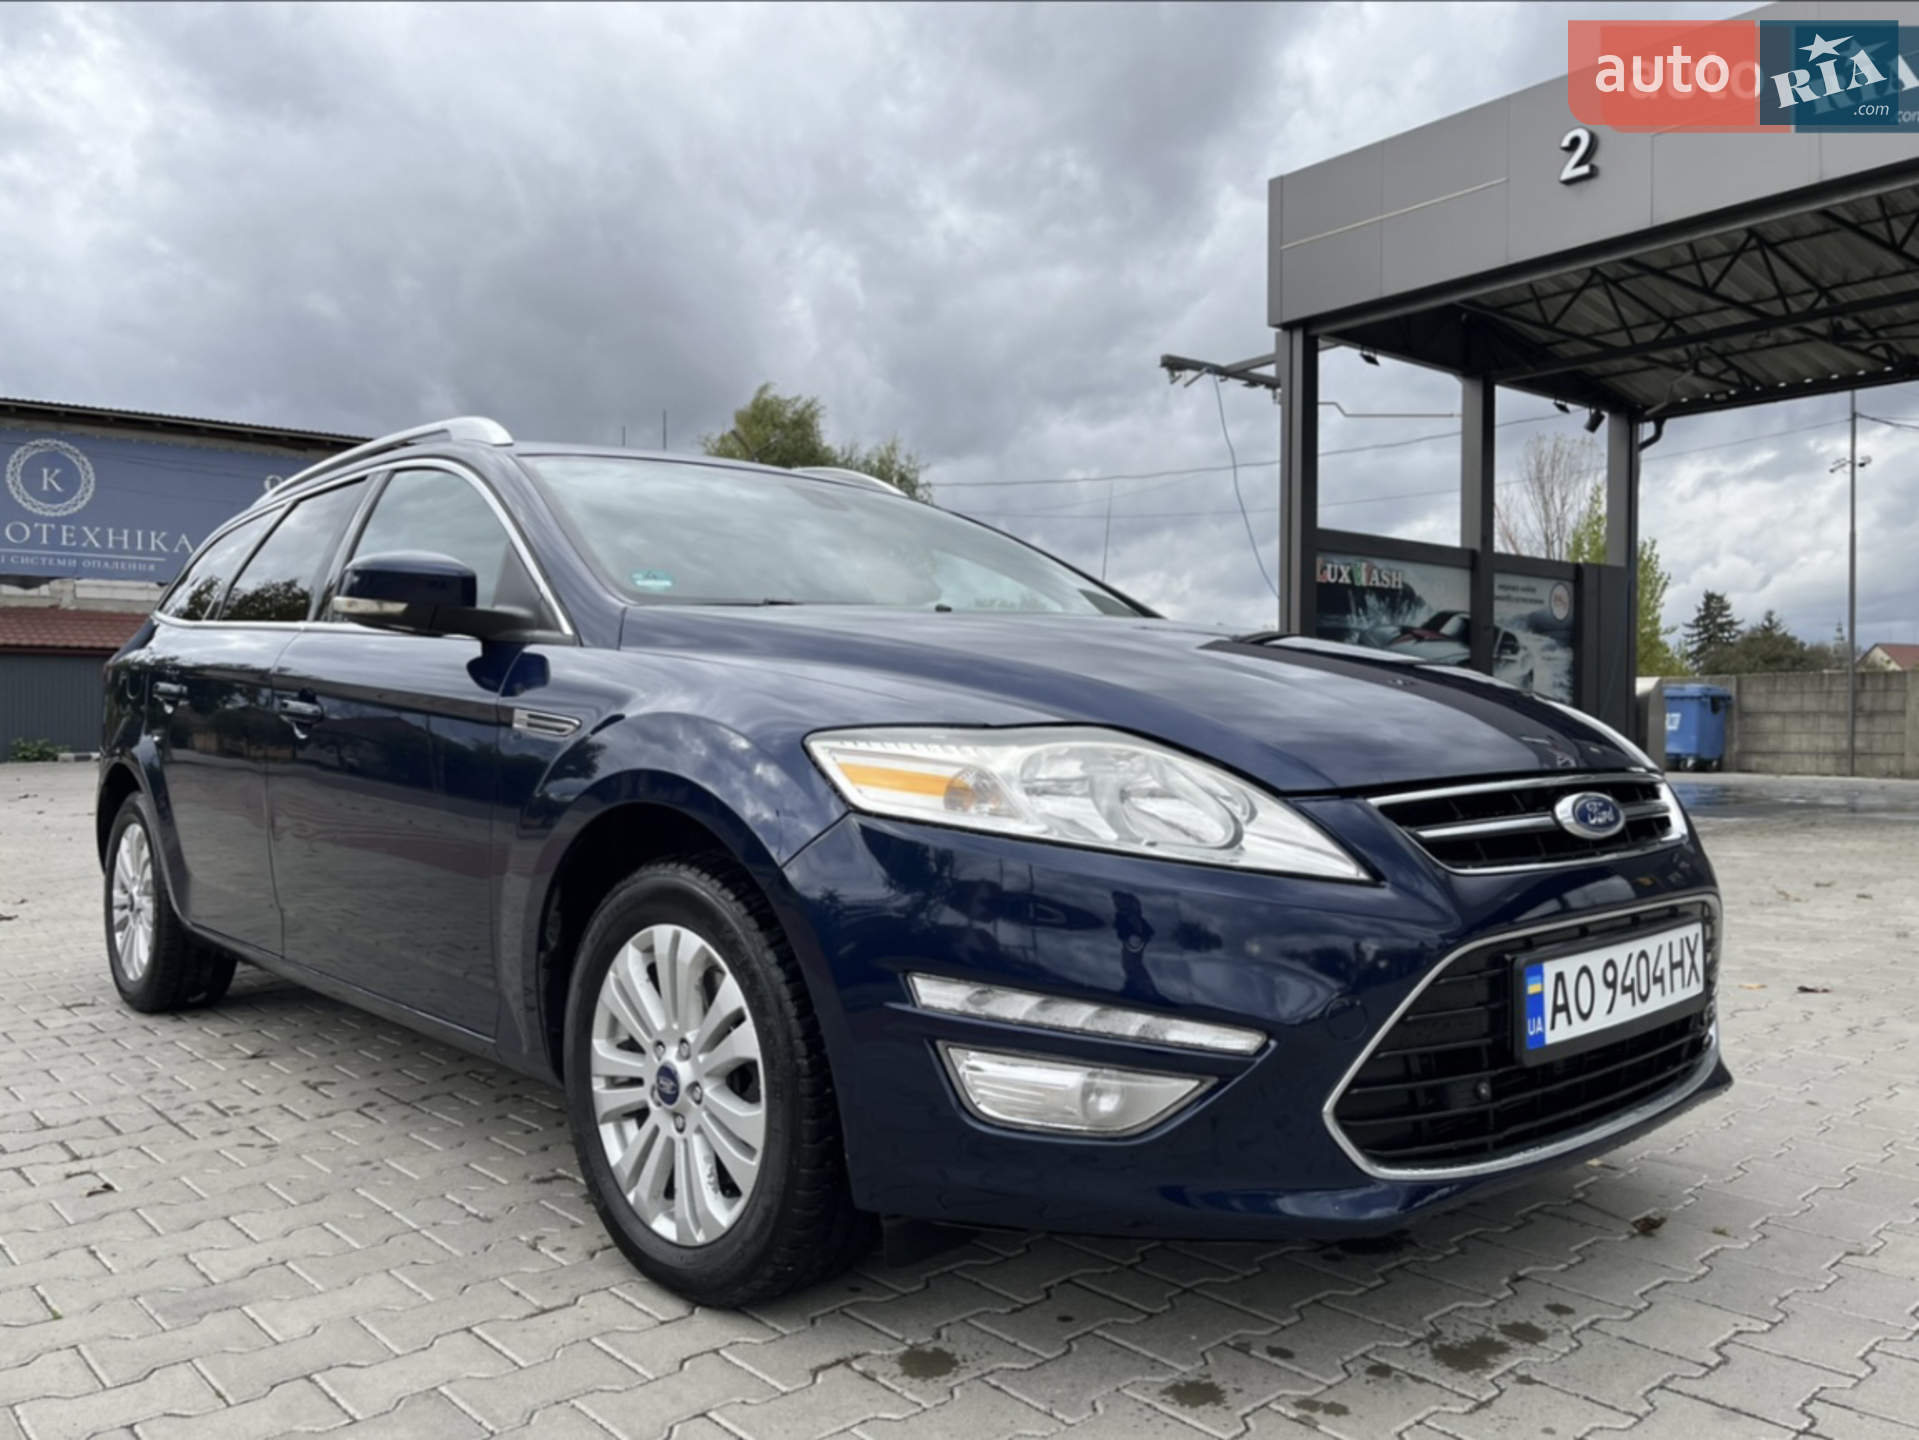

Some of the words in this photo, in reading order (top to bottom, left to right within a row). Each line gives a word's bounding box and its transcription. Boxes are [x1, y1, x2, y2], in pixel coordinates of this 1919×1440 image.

[1559, 127, 1598, 185] 2
[10, 554, 77, 568] СИСТЕМИ
[1527, 1015, 1544, 1036] UA
